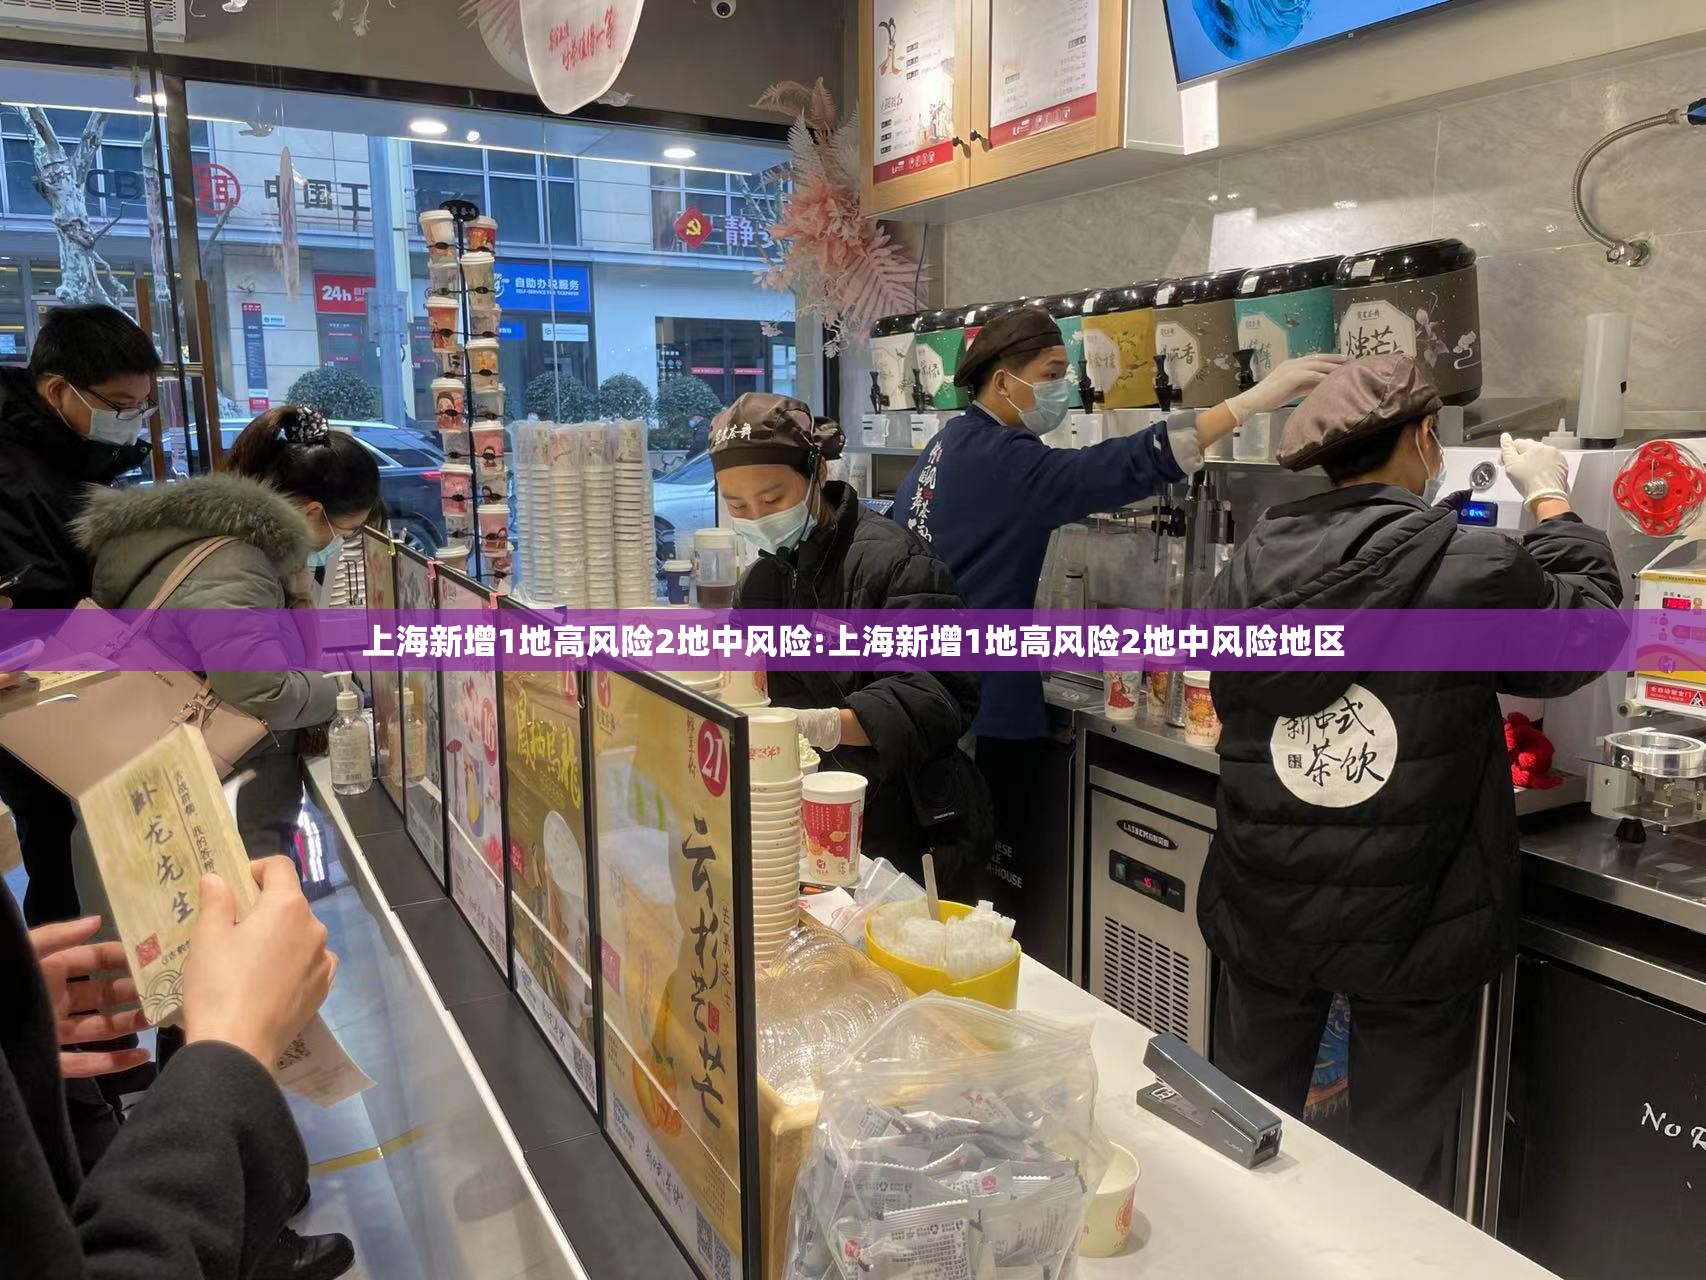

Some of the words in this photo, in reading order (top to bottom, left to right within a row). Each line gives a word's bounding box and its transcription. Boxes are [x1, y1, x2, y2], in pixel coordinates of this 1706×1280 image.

[322, 285, 352, 302] 24h
[515, 277, 580, 291] 自助办税服务
[1282, 695, 1376, 745] 新中式
[701, 730, 722, 785] 21
[1304, 737, 1385, 787] 茶饮
[129, 780, 194, 924] 卧龙先生
[1641, 1102, 1681, 1137] No
